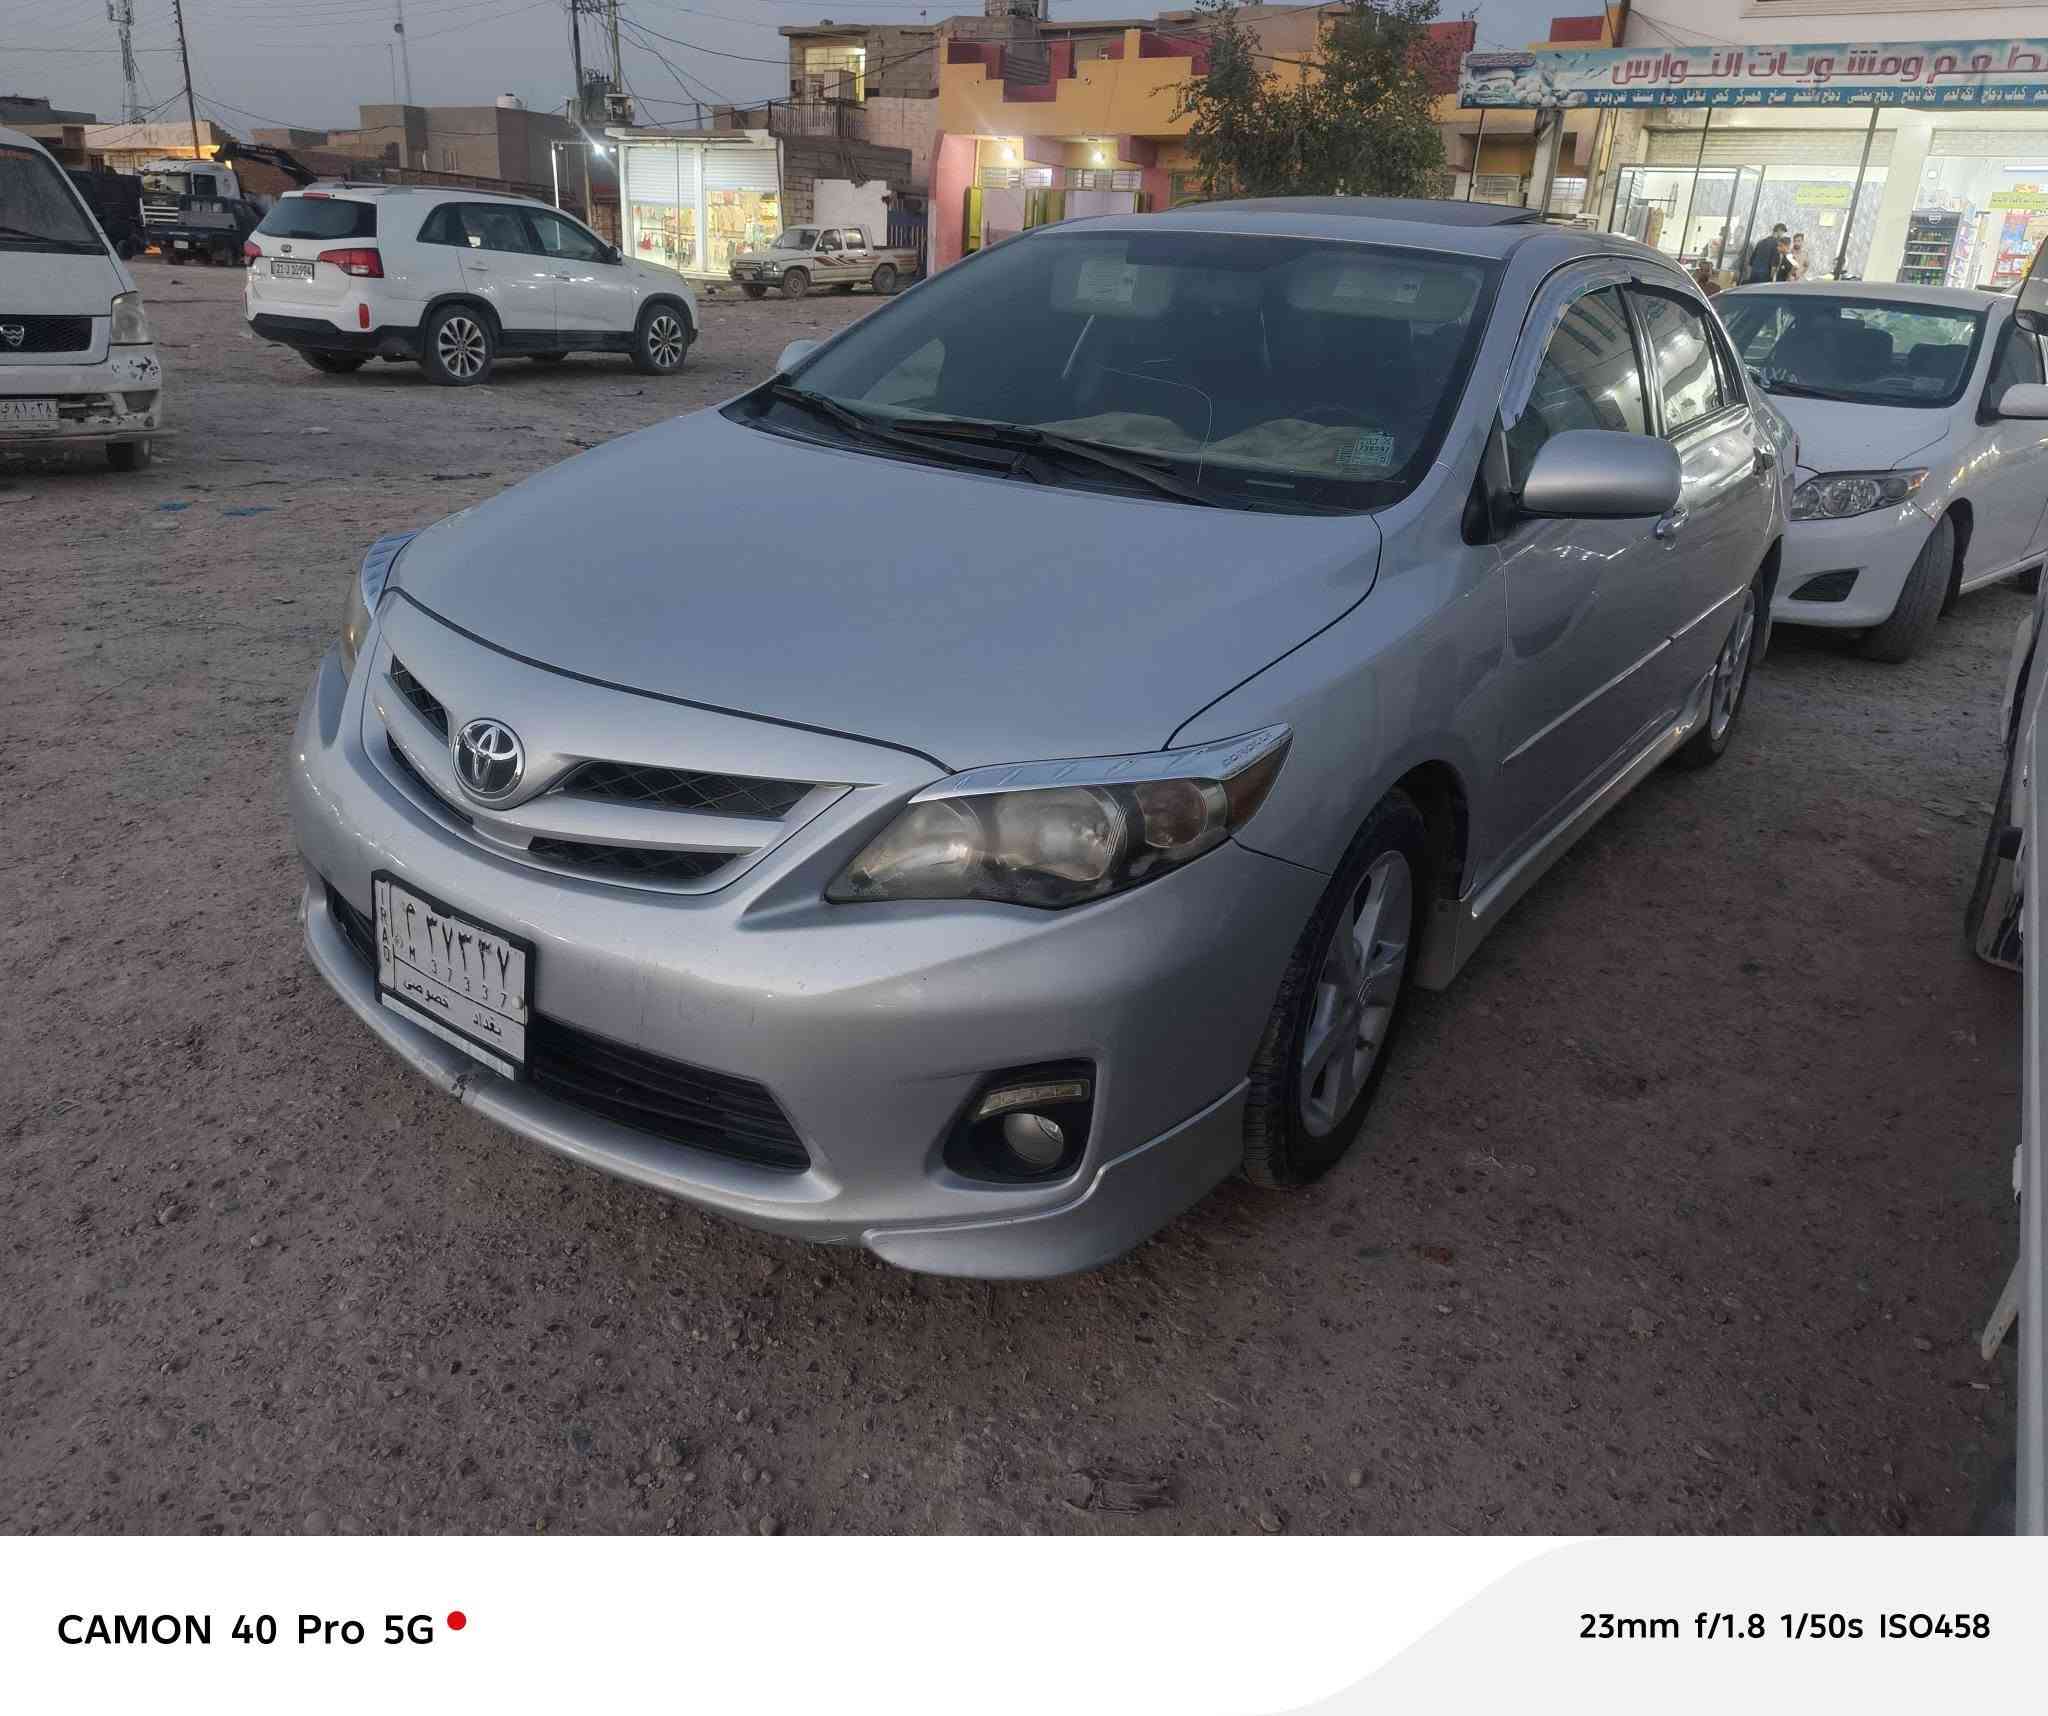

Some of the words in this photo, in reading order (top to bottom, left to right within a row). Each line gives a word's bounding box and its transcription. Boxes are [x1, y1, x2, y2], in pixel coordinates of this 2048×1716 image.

[1612, 51, 1744, 85] النوارس
[1749, 50, 1925, 84] ومشويات
[1927, 44, 2048, 84] طعم
